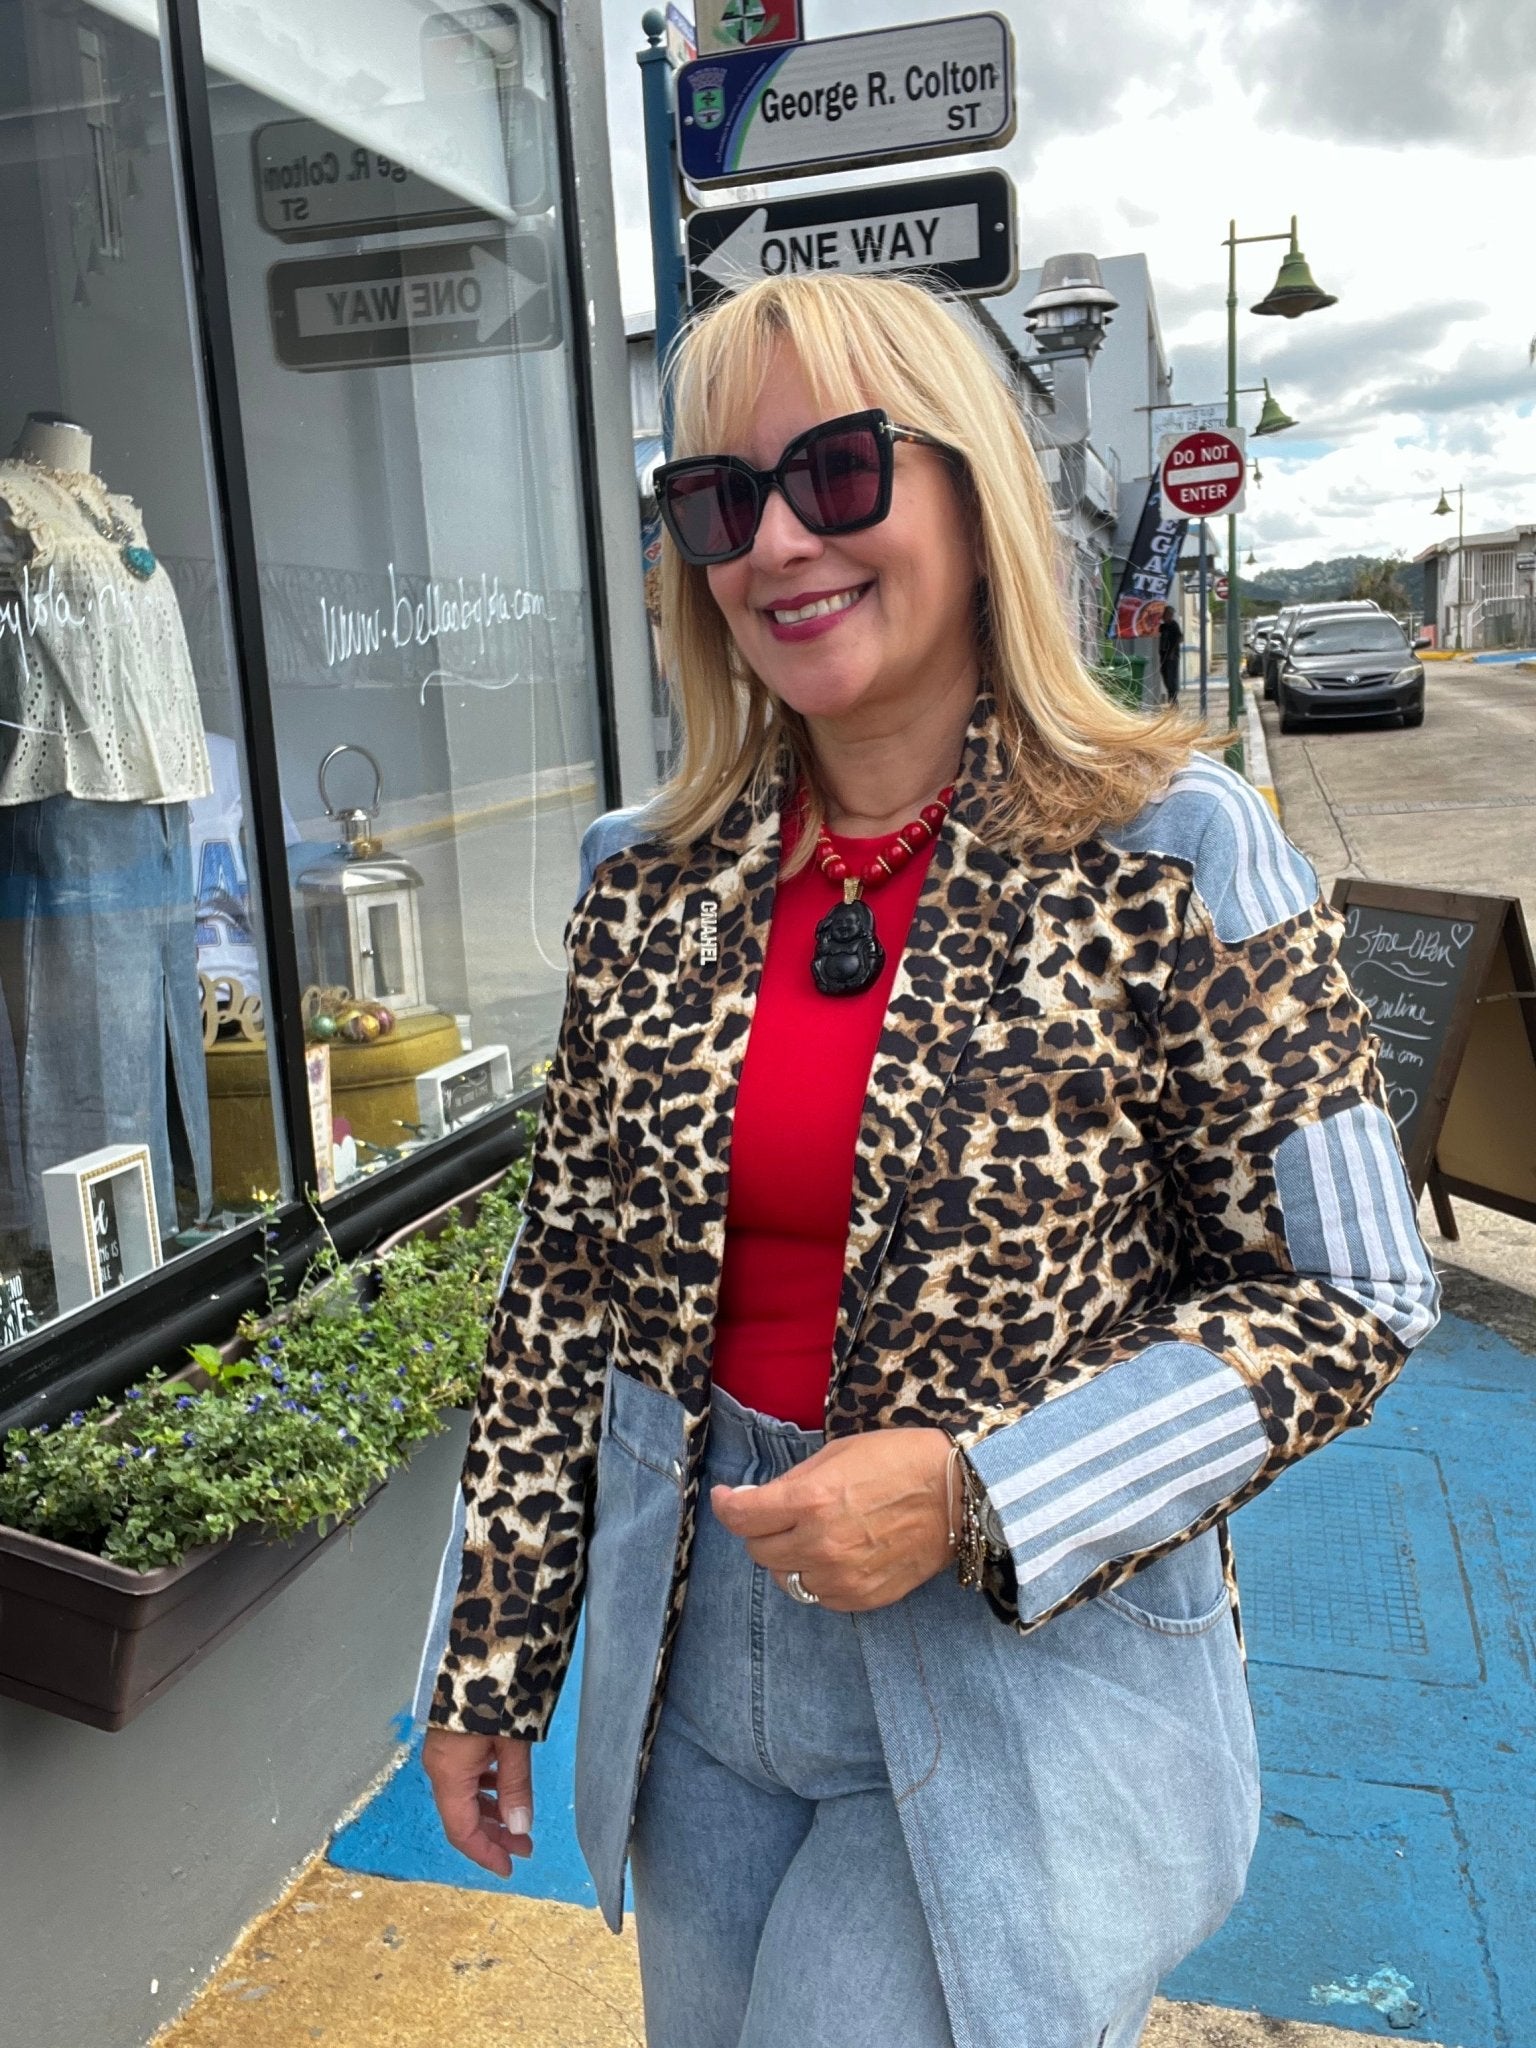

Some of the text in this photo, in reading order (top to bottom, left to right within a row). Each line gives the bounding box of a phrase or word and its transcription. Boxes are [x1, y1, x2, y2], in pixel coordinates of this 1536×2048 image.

[761, 61, 997, 123] George R. Colton
[948, 102, 981, 131] ST
[760, 217, 940, 276] ONE WAY
[1173, 444, 1231, 466] DO NOT
[1180, 484, 1228, 503] ENTER
